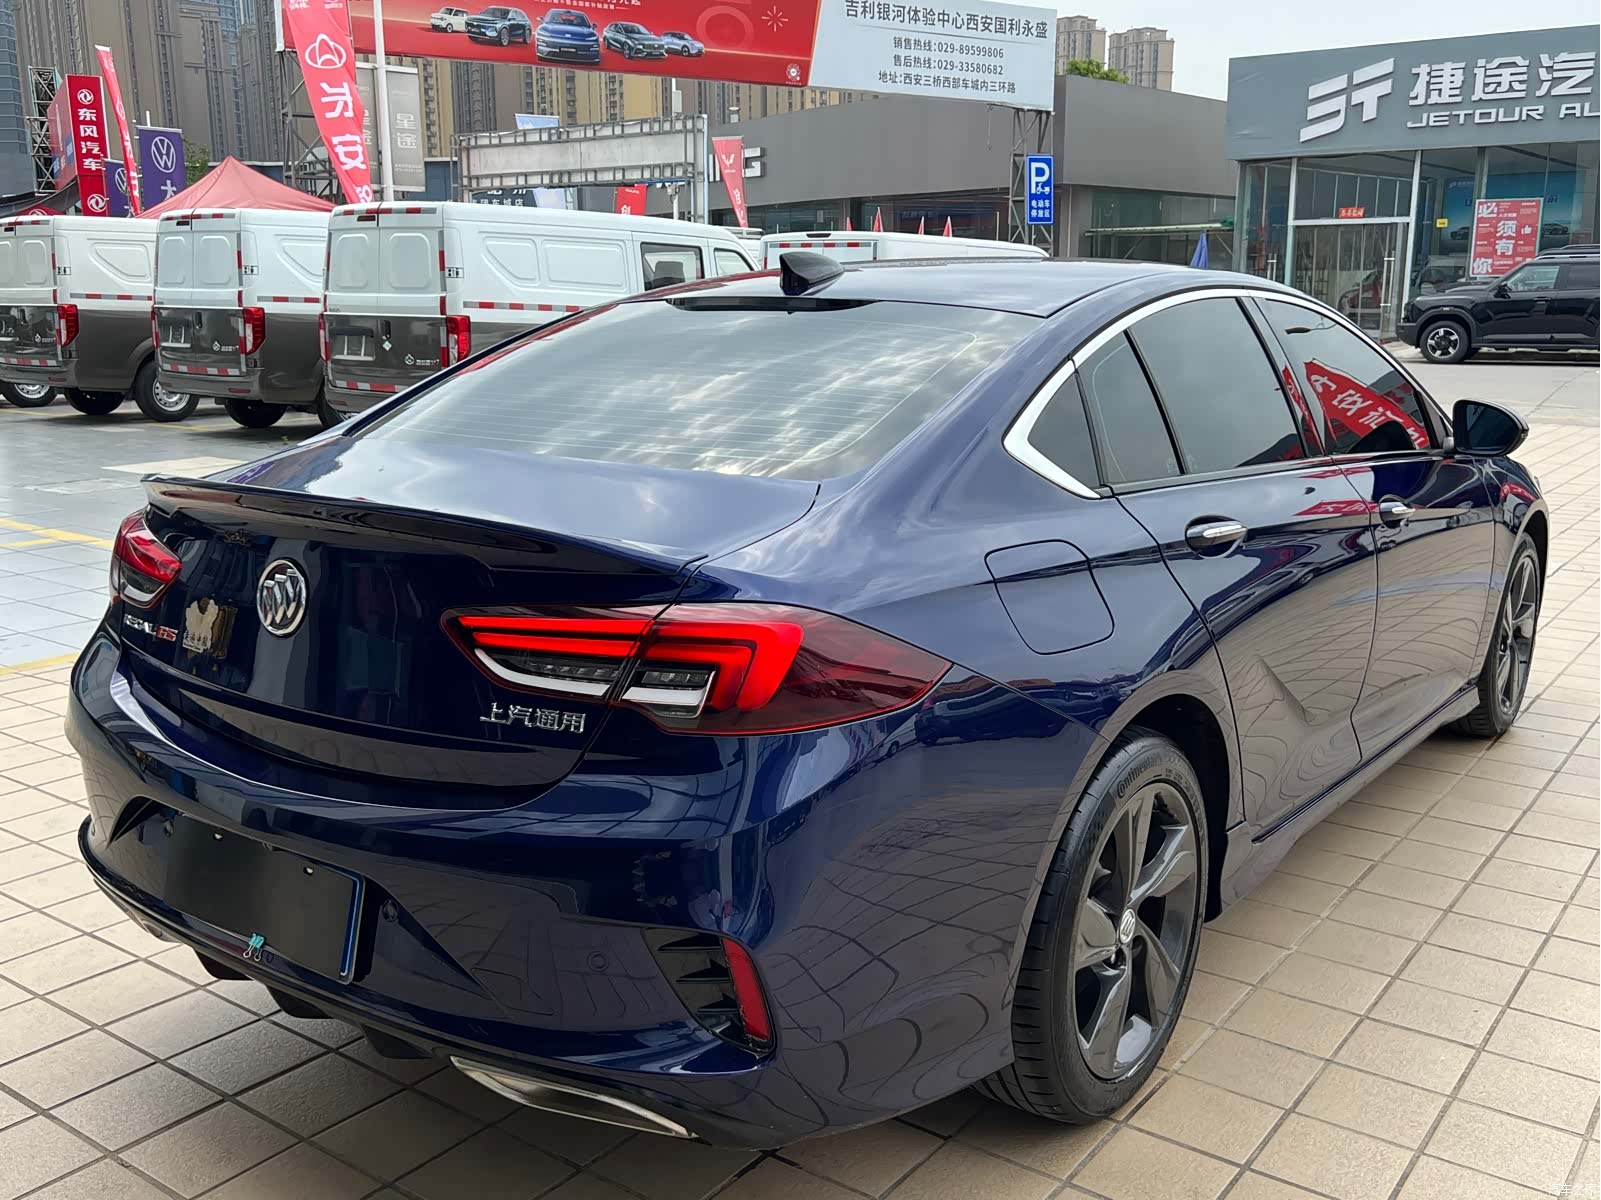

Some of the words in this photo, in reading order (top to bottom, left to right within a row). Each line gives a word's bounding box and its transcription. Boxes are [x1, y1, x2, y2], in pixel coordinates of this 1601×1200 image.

[845, 0, 1048, 39] 吉利银河体验中心西安国利永盛
[893, 36, 1004, 58] 销售热线:029-89599806
[893, 53, 1004, 75] 售后热线:029-33580682
[878, 70, 1016, 94] 地址:西安三桥西部车城内三环路
[1408, 52, 1596, 106] 捷途汽
[395, 113, 417, 148] 星途
[1407, 105, 1544, 128] JETOUR
[77, 108, 102, 170] 东风汽车
[1031, 162, 1050, 194] P
[1031, 199, 1050, 208] 电动车
[1031, 209, 1050, 218] 停放区
[479, 702, 586, 734] 上汽通用
